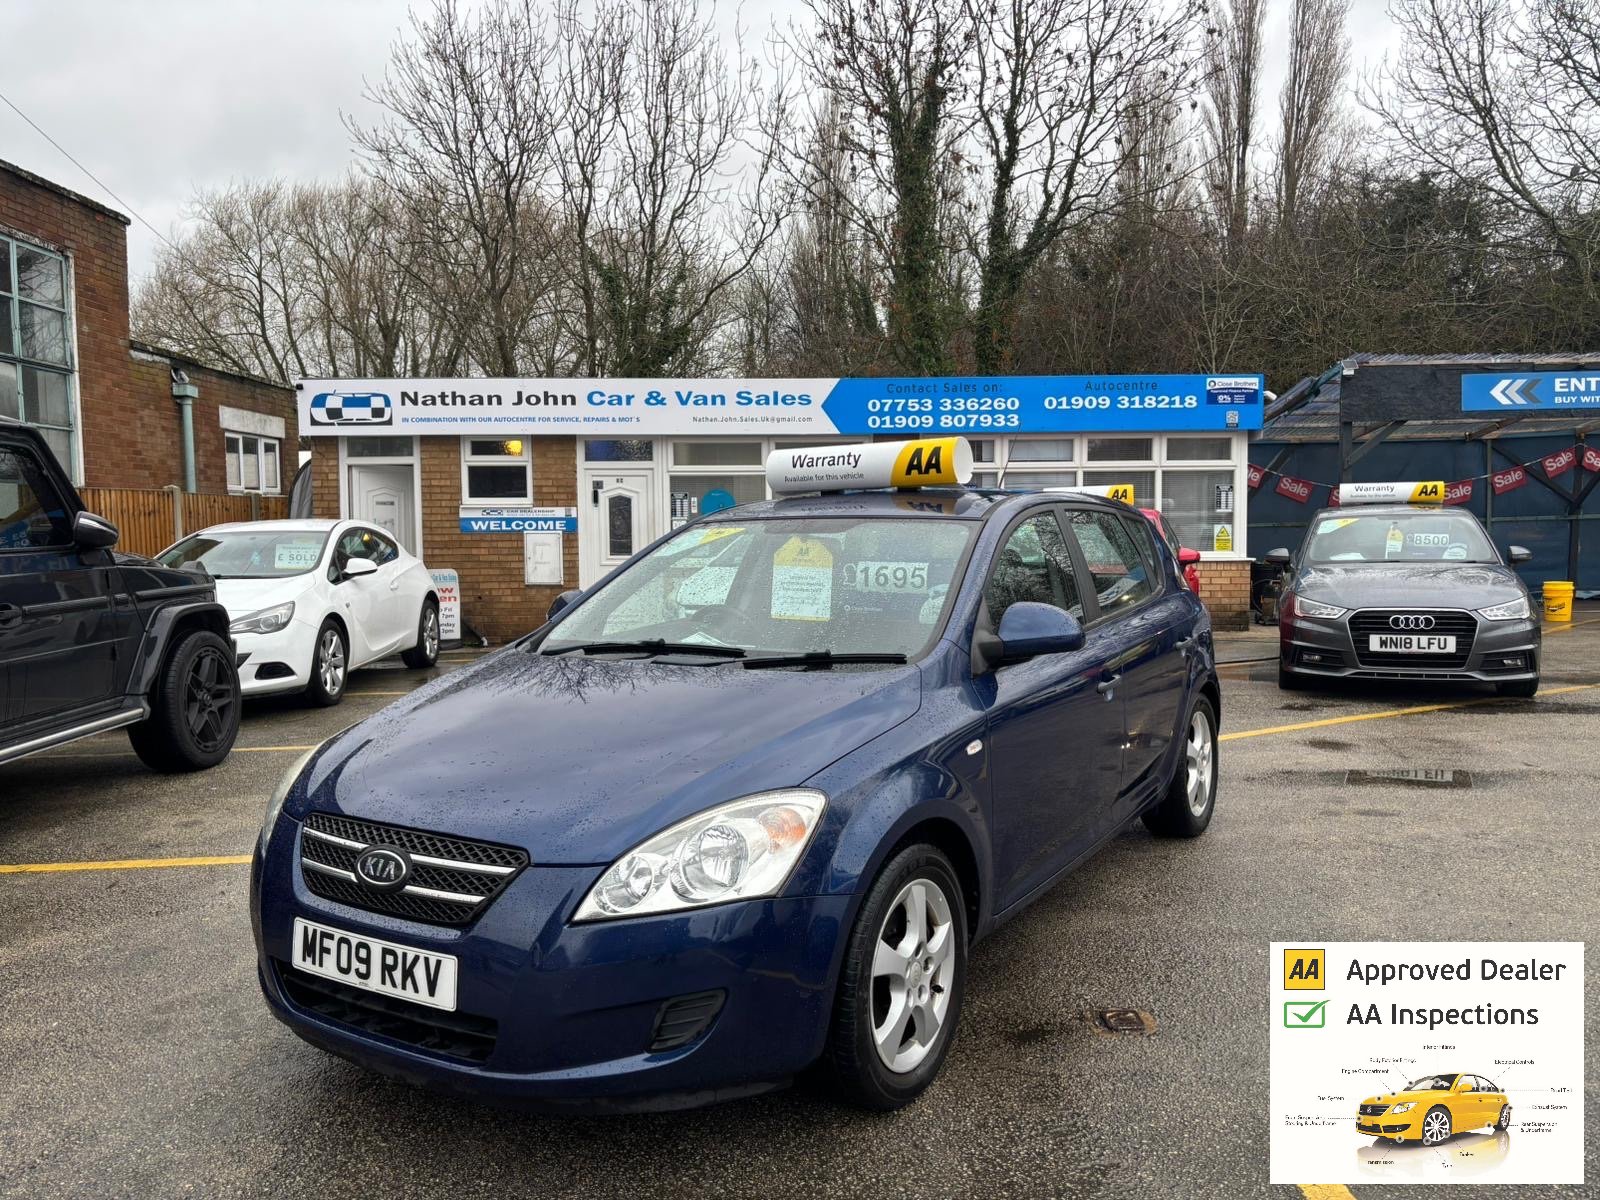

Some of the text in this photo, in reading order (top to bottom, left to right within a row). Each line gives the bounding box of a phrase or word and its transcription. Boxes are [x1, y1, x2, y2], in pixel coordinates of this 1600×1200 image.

[887, 383, 938, 393] Contact
[944, 382, 977, 392] Sales
[1085, 380, 1158, 391] Autocentre
[1554, 377, 1600, 392] ENT
[401, 390, 812, 406] Nathan John Car & Van Sales
[868, 398, 1020, 412] 07753 336260
[1044, 395, 1198, 409] 01909 318218
[1555, 396, 1578, 404] BUY
[868, 414, 1020, 428] 01909 807933
[792, 446, 942, 476] Warranty AA
[1545, 452, 1572, 471] Sale
[1584, 450, 1600, 467] Sa
[784, 472, 864, 483] Available for this vehicle
[1248, 468, 1261, 481] le
[1494, 470, 1523, 488] Sale
[1112, 488, 1128, 500] AA
[1280, 477, 1308, 497] Sale
[1418, 485, 1438, 496] AA
[1444, 484, 1472, 500] Sale
[470, 520, 566, 530] WELCOME
[1380, 636, 1447, 650] WN18 LFU
[364, 857, 395, 880] KIA
[302, 925, 442, 998] MF09 RKV
